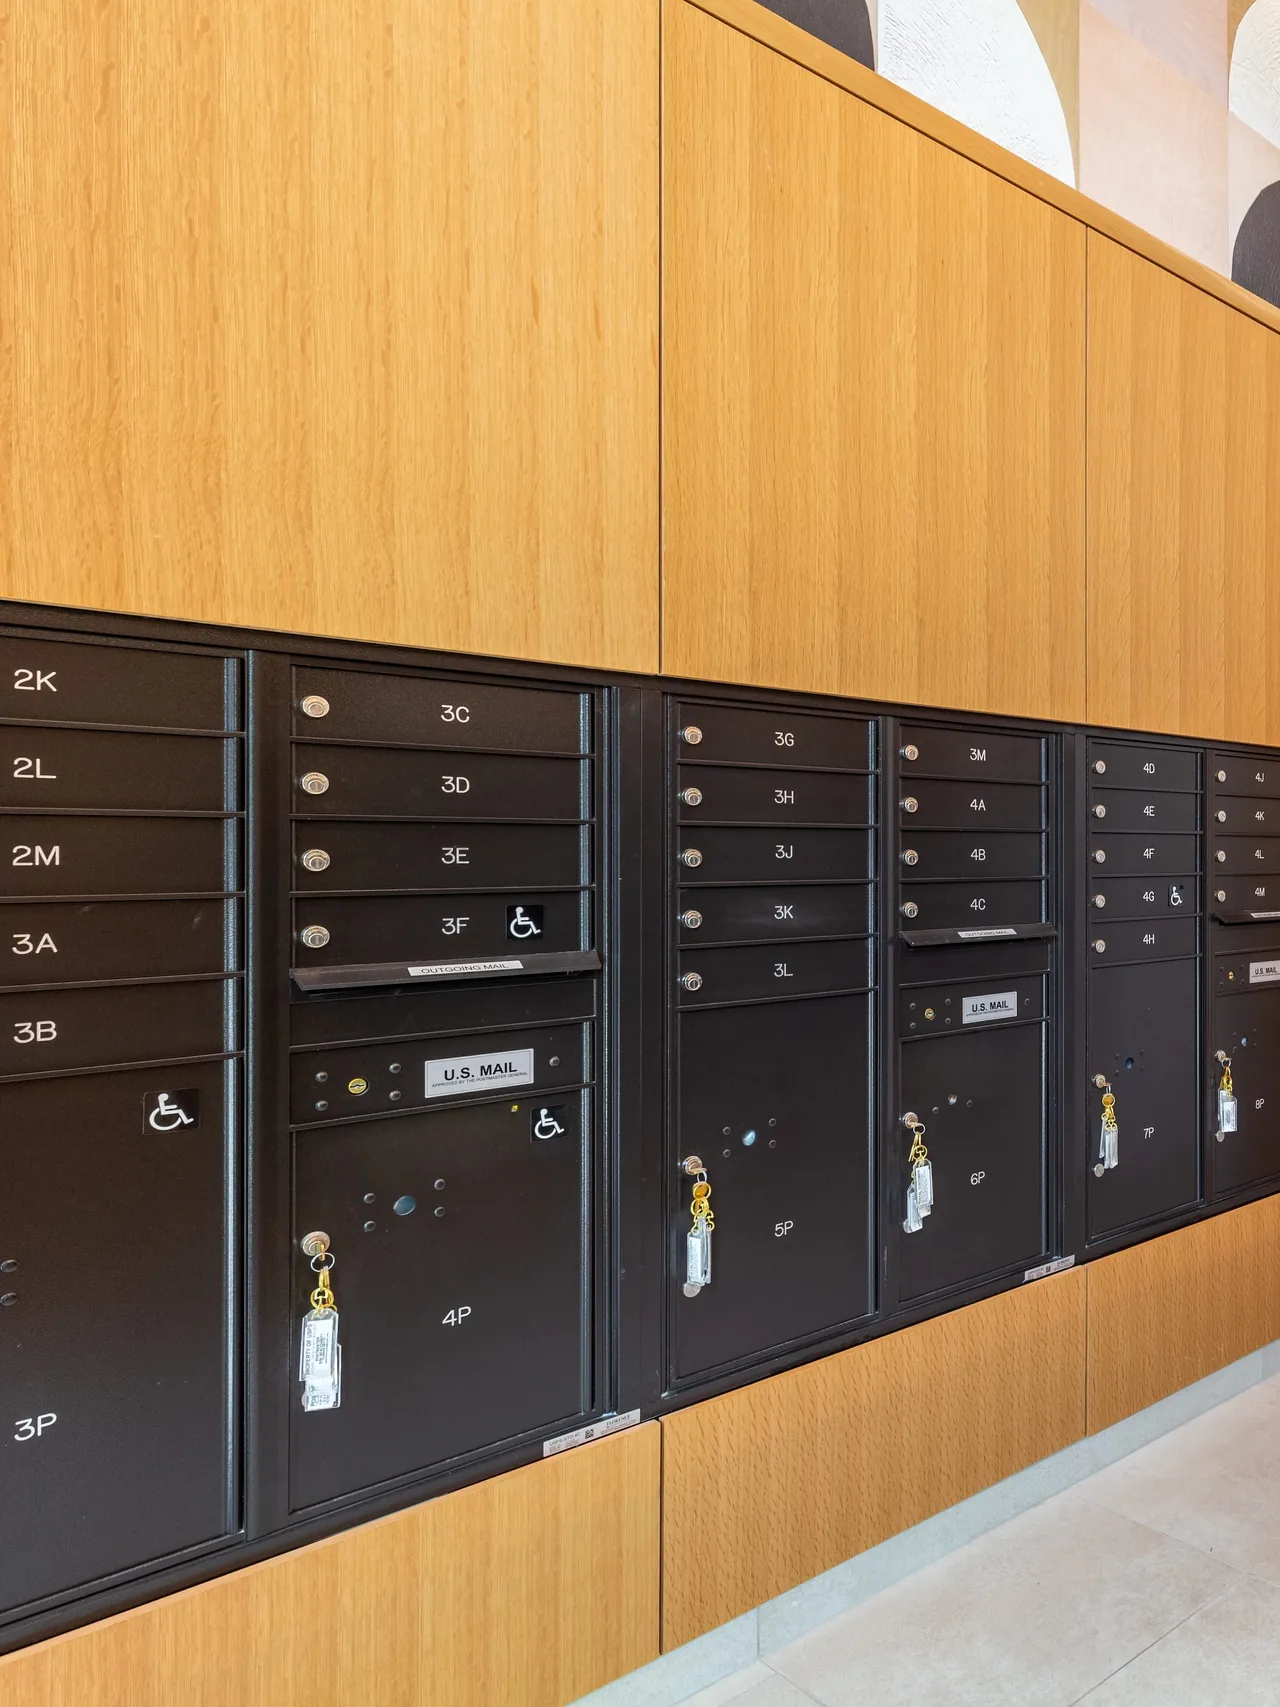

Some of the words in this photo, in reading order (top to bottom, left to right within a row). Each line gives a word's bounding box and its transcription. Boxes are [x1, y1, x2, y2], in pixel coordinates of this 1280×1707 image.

[13, 668, 58, 692] 2K
[440, 704, 470, 724] 3C
[774, 731, 795, 747] 3G
[969, 748, 986, 762] 3M
[13, 757, 57, 779] 2L
[1143, 762, 1156, 774] 4D
[441, 775, 470, 794] 3D
[1255, 772, 1265, 783] 4J
[774, 789, 794, 805] 3H
[969, 798, 987, 811] 4A
[1143, 805, 1155, 817] 4E
[1254, 810, 1265, 821] 4K
[12, 845, 60, 867] 2M
[441, 847, 470, 865] 3E
[775, 844, 793, 859] 3J
[970, 848, 986, 861] 4B
[1143, 848, 1155, 859] 4F
[1254, 849, 1265, 859] 4L
[1142, 890, 1155, 902] 4G
[1254, 887, 1266, 897] 4M
[970, 898, 986, 911] 4C
[774, 905, 794, 920] 3K
[441, 916, 470, 935] 3F
[11, 932, 58, 955] 3A
[1142, 933, 1155, 945] 4H
[421, 966, 482, 974] OUTGOING
[773, 963, 794, 978] 3L
[972, 1003, 988, 1012] U.S.
[990, 1000, 1009, 1009] MAIL
[13, 1020, 58, 1044] 3B
[444, 1067, 475, 1081] U.S.
[480, 1062, 517, 1077] MAIL
[432, 1080, 458, 1088] APPROVED
[476, 1074, 506, 1082] POSTMASTER
[1255, 1098, 1265, 1110] 8P
[1143, 1126, 1155, 1139] 7P
[970, 1170, 986, 1186] 6P
[774, 1220, 794, 1238] 5P
[441, 1305, 472, 1327] 4P
[13, 1412, 58, 1442] 3P
